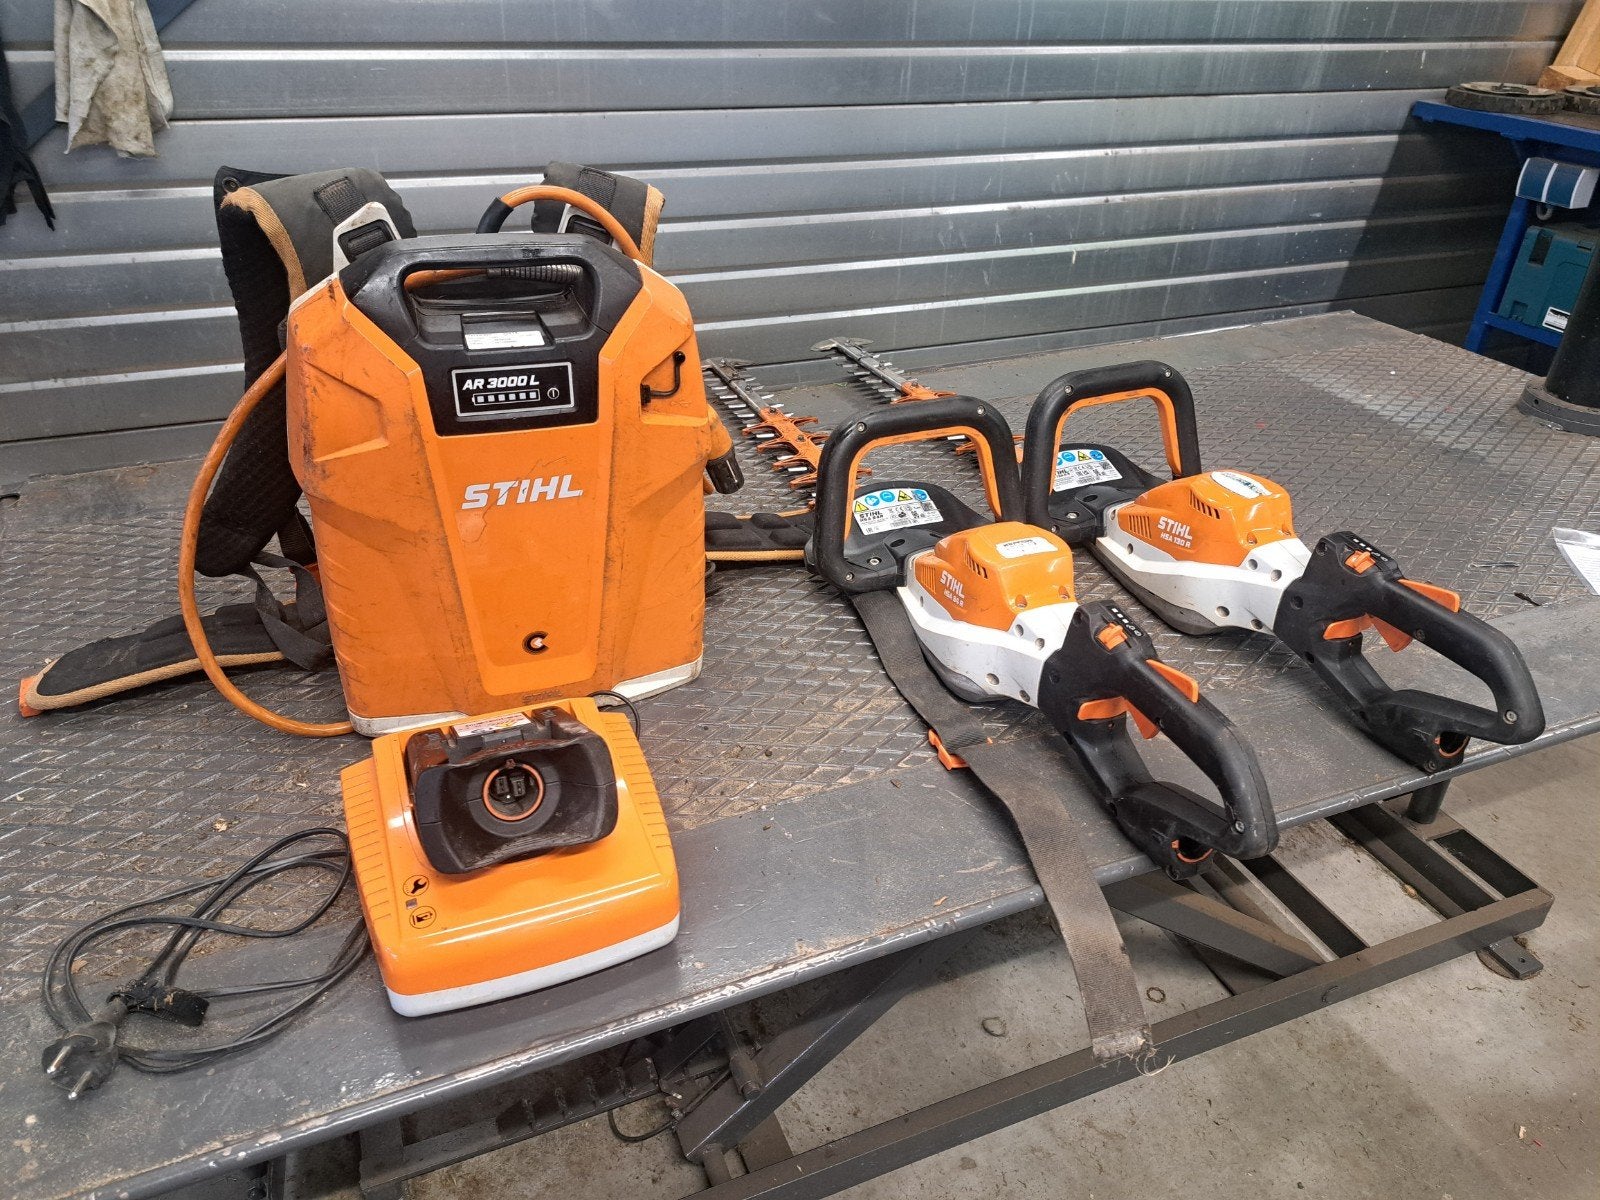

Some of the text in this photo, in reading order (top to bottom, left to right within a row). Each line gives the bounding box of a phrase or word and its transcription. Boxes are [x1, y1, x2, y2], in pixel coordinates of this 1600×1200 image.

[462, 374, 540, 391] AR 3000 L
[461, 474, 584, 510] STIHL
[859, 510, 883, 519] STIHL
[1157, 515, 1193, 541] STIHL
[1160, 531, 1192, 549] HSA 130 R
[940, 570, 965, 598] STIHL
